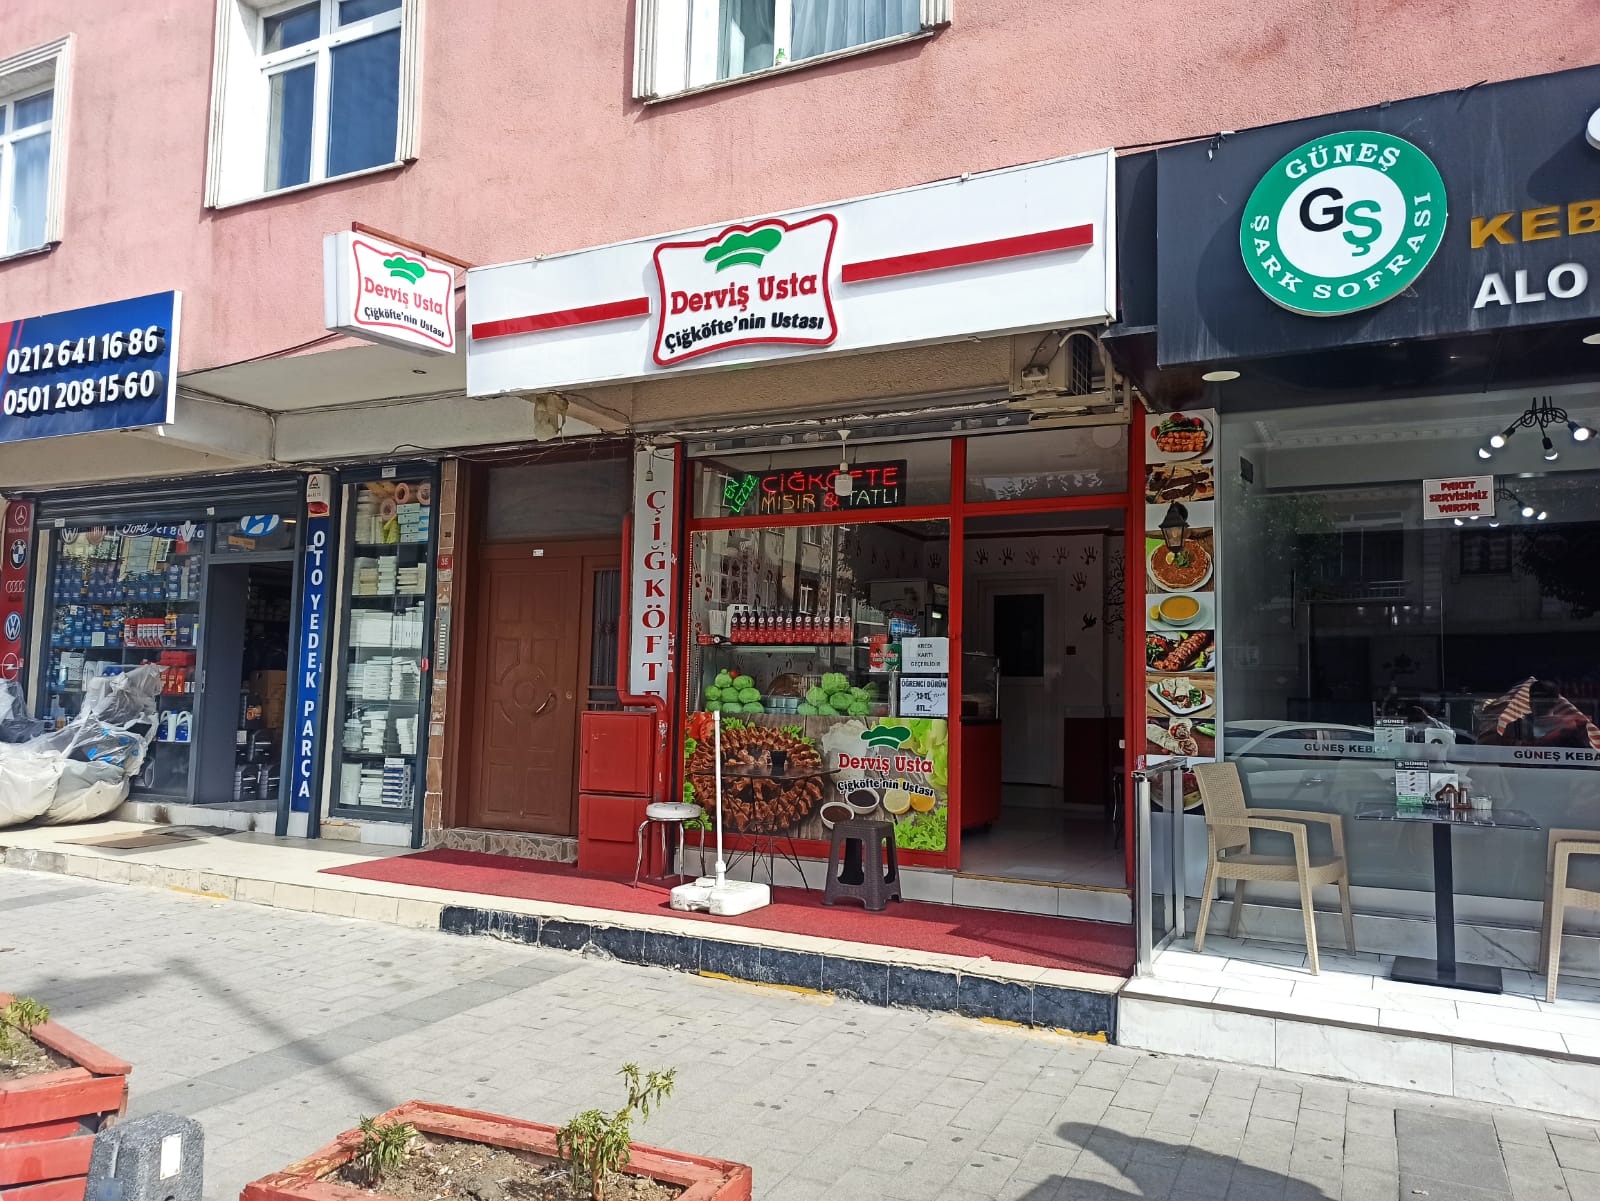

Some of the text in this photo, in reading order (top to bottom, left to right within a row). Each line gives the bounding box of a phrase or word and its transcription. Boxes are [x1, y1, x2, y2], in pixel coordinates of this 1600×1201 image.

[1285, 143, 1400, 180] GÜNEŞ
[1250, 192, 1432, 299] ŞARK SOFRASI
[364, 276, 443, 315] Derviş Usta
[670, 272, 817, 312] Derviş Usta
[1473, 262, 1588, 309] ALO
[364, 306, 445, 338] Çiğköfte'nin Ustası
[771, 312, 825, 330] Ustası
[6, 325, 158, 375] 0212 641 16 86
[3, 369, 155, 415] 0501 208 15 60
[850, 488, 898, 505] TATLI
[641, 490, 667, 700] ÇİĞKÖFT
[298, 530, 326, 797] OTO YEDEK PARÇA
[838, 753, 933, 776] Derviş Usta
[1513, 750, 1561, 762] GÜNEŞ
[837, 778, 935, 797] Çiğköfte'nin Ustası
